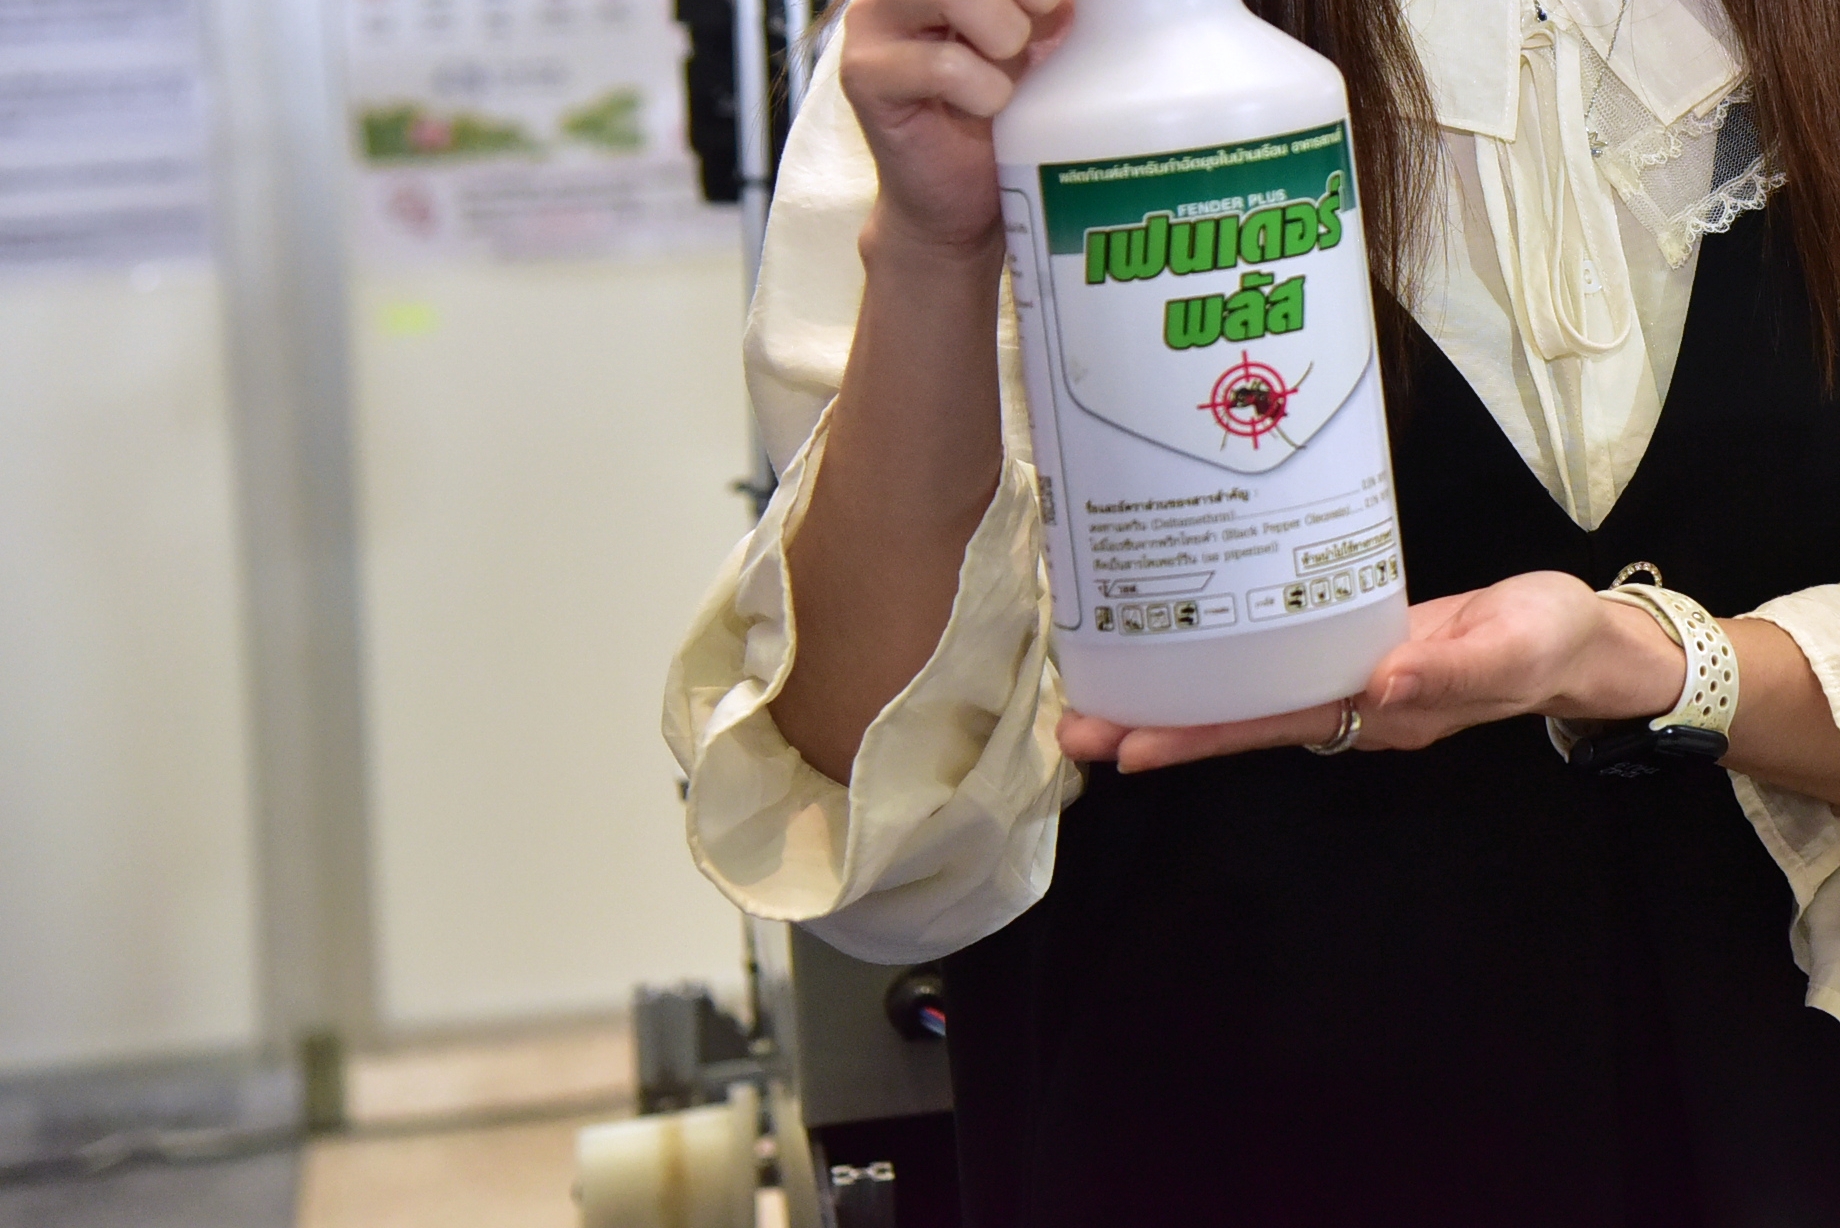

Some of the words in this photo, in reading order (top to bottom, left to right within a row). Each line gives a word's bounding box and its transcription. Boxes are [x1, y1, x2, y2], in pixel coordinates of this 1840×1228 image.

[1085, 171, 1343, 284] เฟนเดอร์
[1177, 195, 1245, 217] FENDER
[1248, 189, 1287, 208] PLUS
[1165, 271, 1305, 349] พลัส
